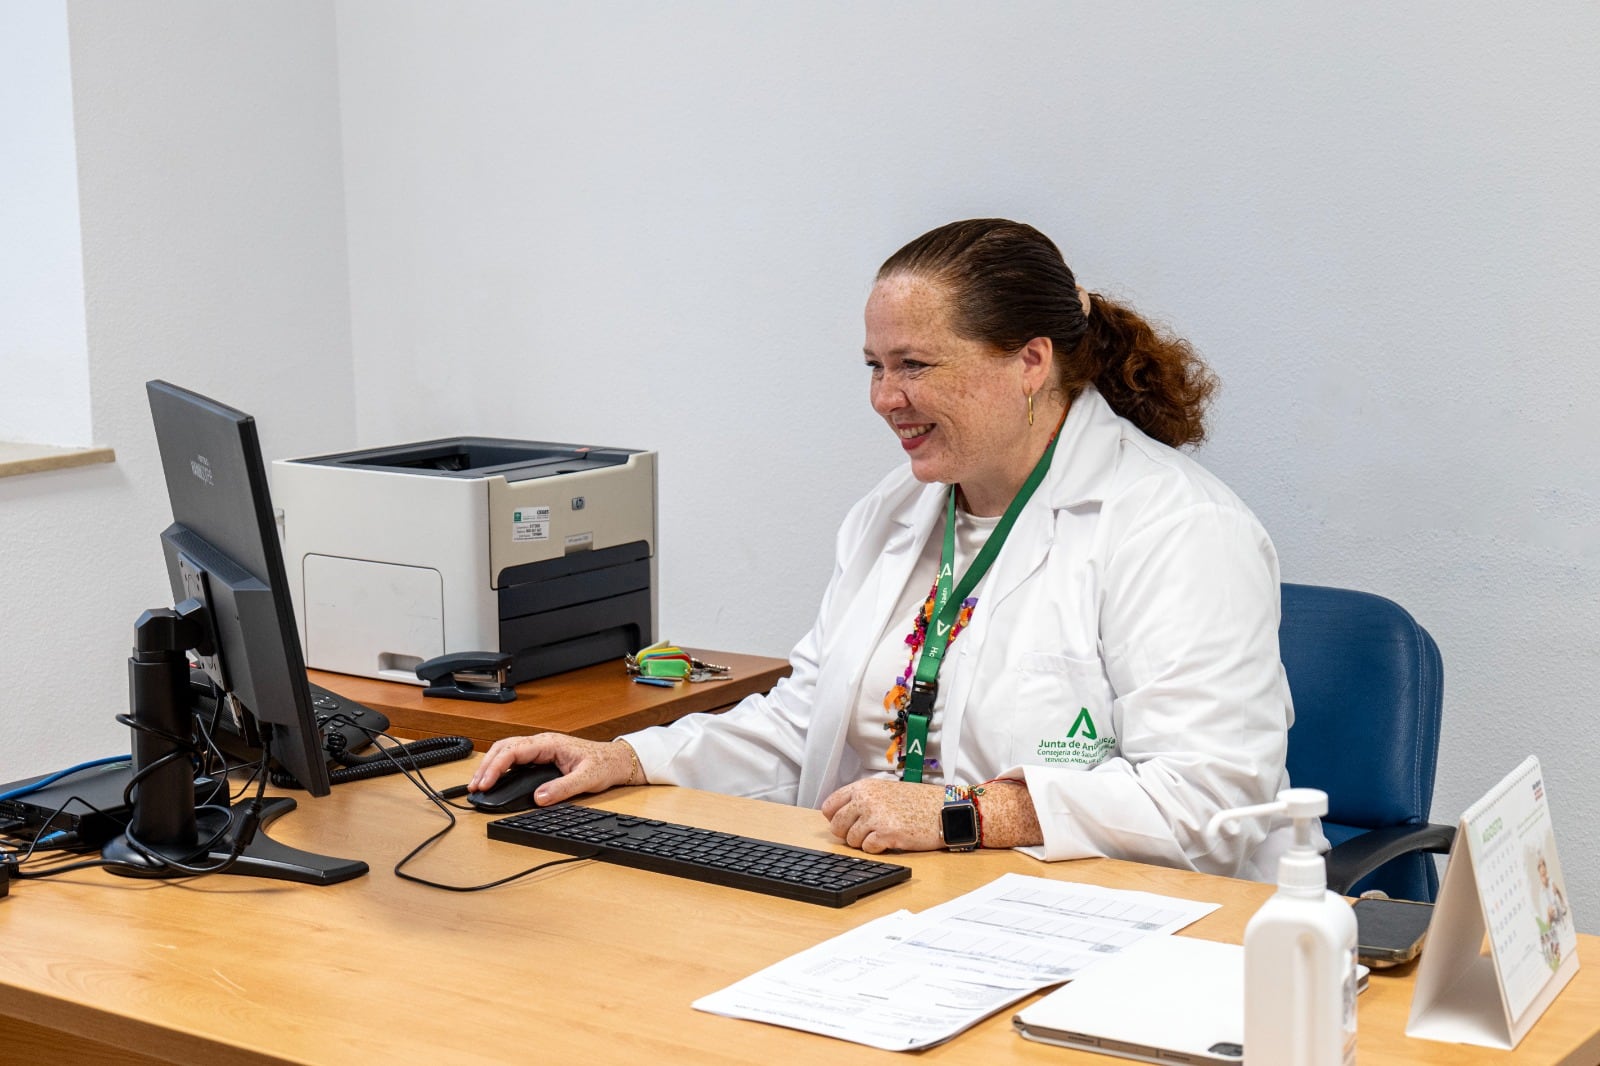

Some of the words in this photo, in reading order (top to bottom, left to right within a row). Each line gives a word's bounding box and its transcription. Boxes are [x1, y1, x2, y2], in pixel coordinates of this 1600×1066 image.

[1038, 739, 1066, 748] Junta
[1068, 740, 1081, 749] de
[1082, 736, 1116, 751] Anducía
